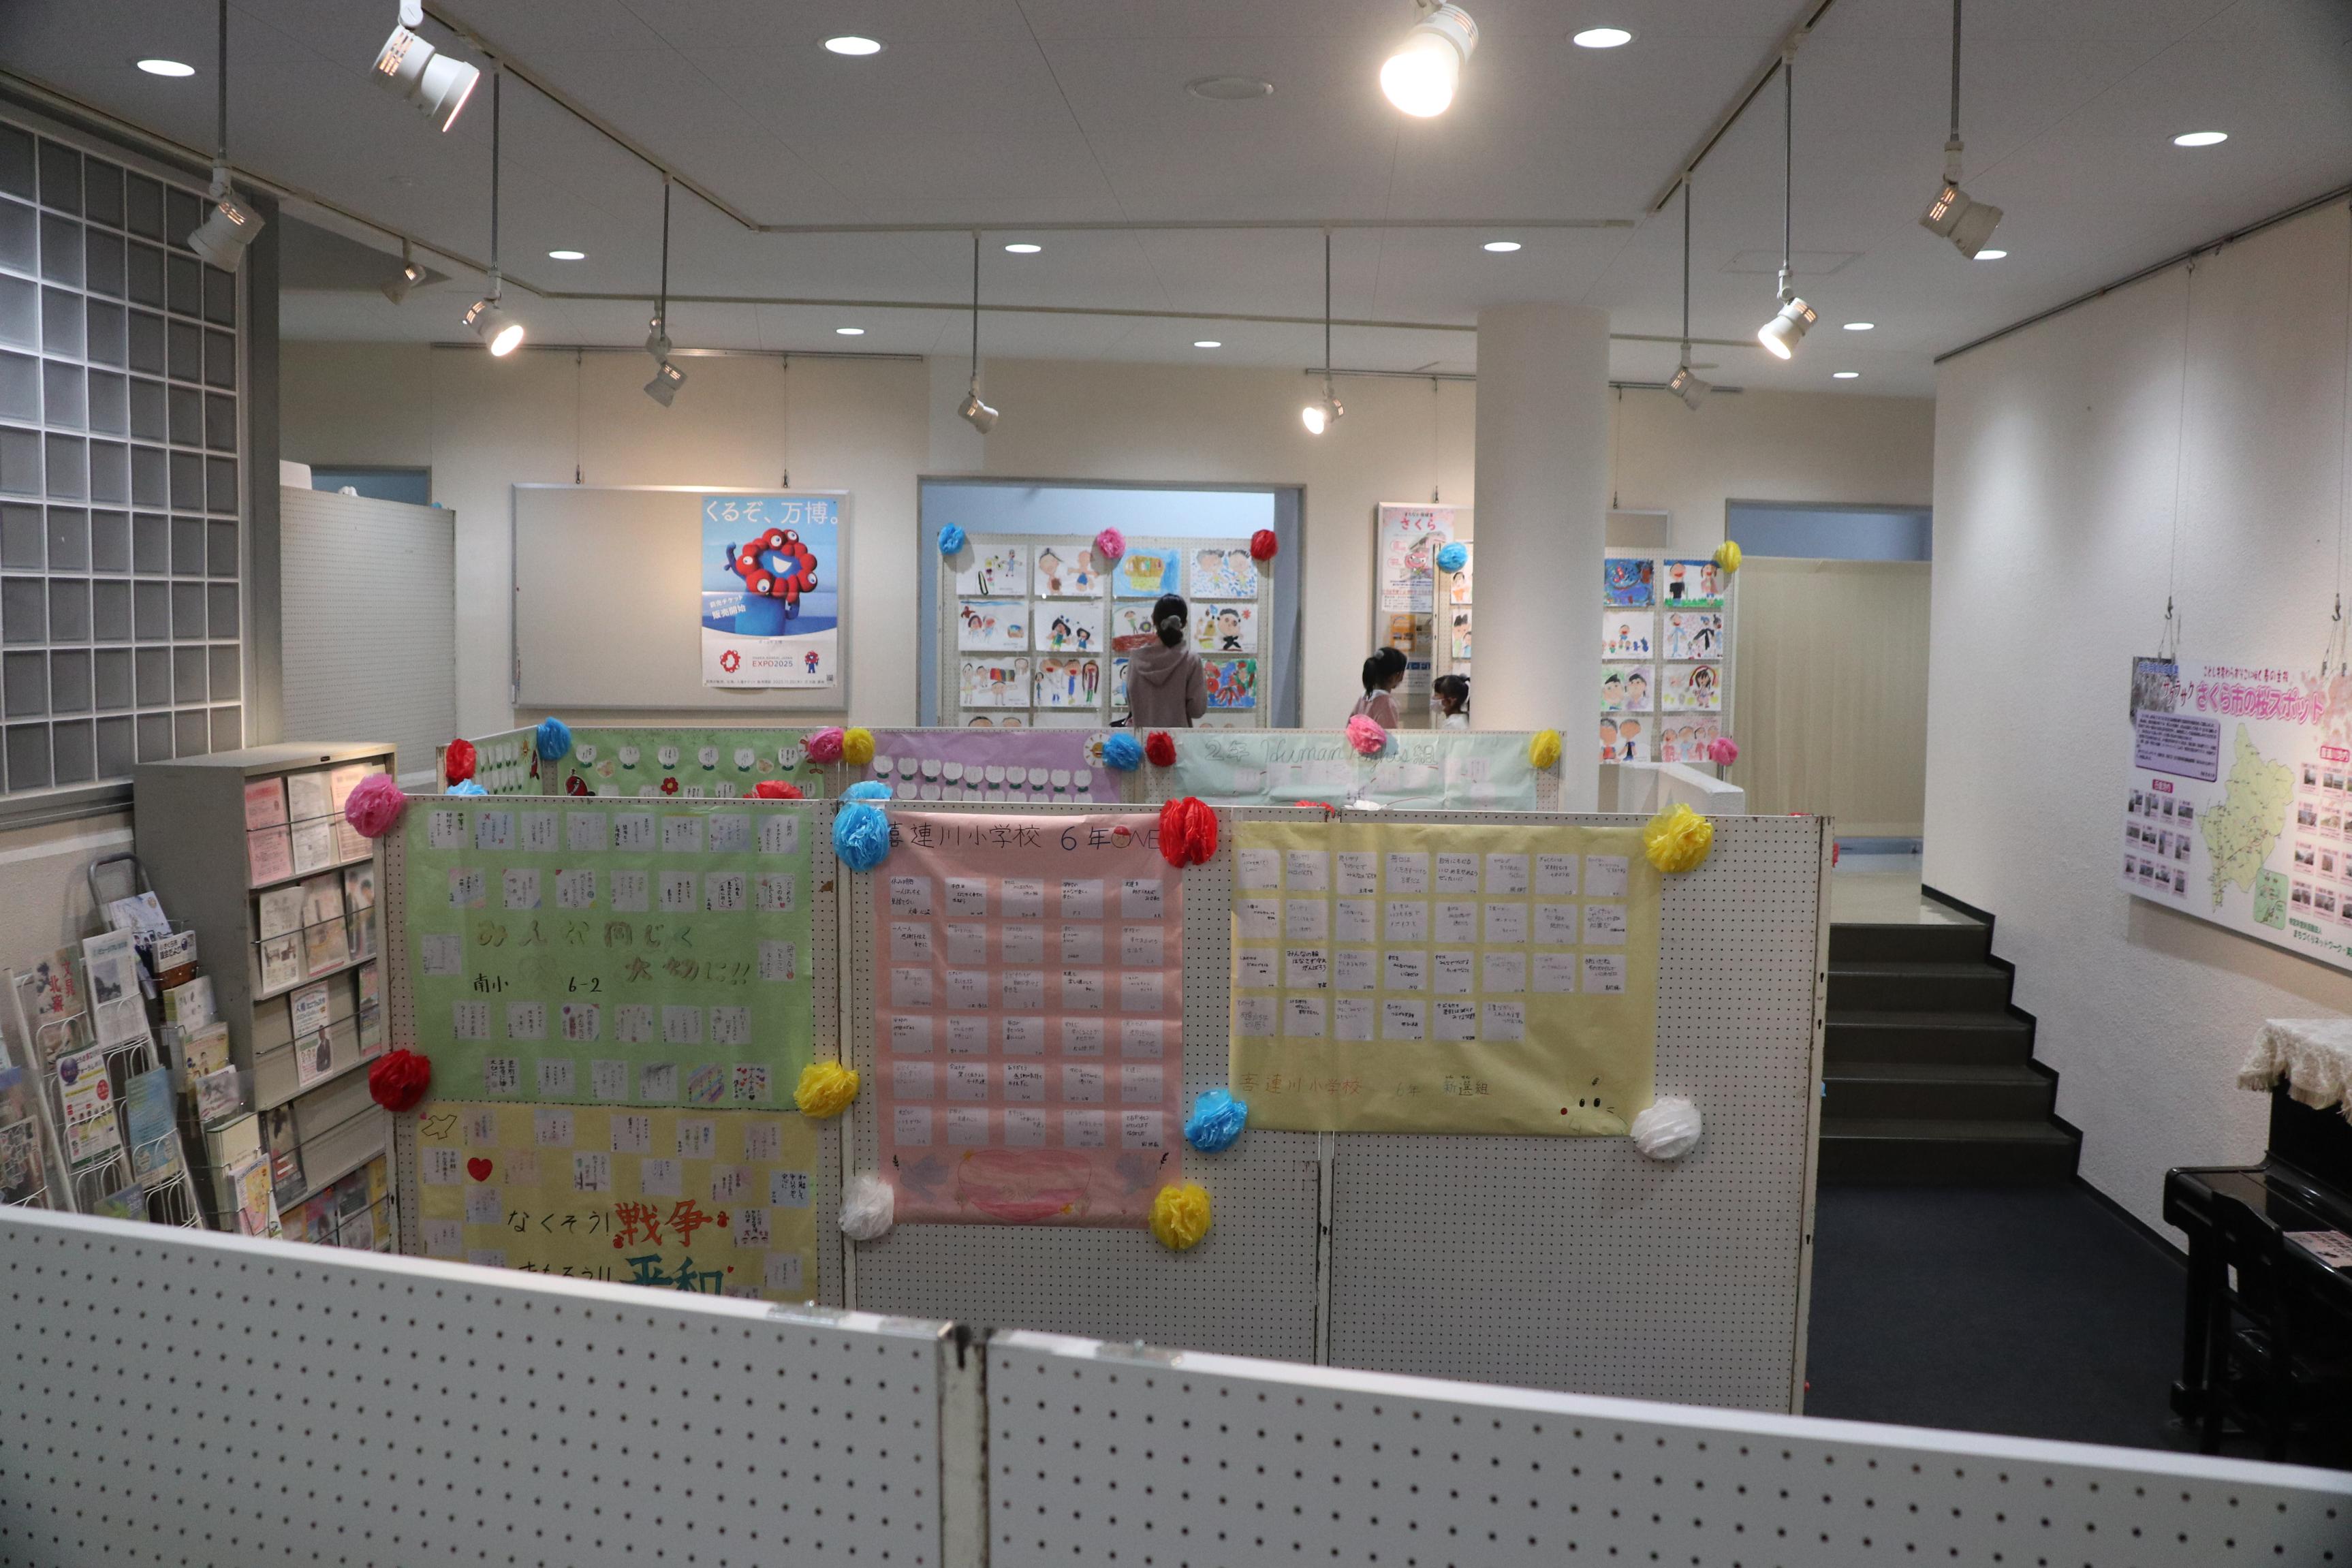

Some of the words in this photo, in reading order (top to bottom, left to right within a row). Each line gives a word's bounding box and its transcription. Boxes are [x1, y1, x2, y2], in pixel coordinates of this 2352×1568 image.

[706, 501, 838, 524] くるぞ、万博。
[1400, 518, 1436, 531] さくら
[712, 603, 746, 620] 販売開始
[2195, 680, 2325, 725] さくら市の桜スポット
[1413, 744, 1439, 766] 組
[888, 820, 1042, 848] 喜連川小学校
[477, 920, 693, 948] みんな同じく
[474, 975, 509, 994] 南小
[568, 975, 603, 993] 6-2
[1443, 1078, 1491, 1097] 新選組
[507, 1208, 611, 1237] なくそう!
[614, 1199, 713, 1248] 戦争
[618, 1253, 724, 1298] 平和
